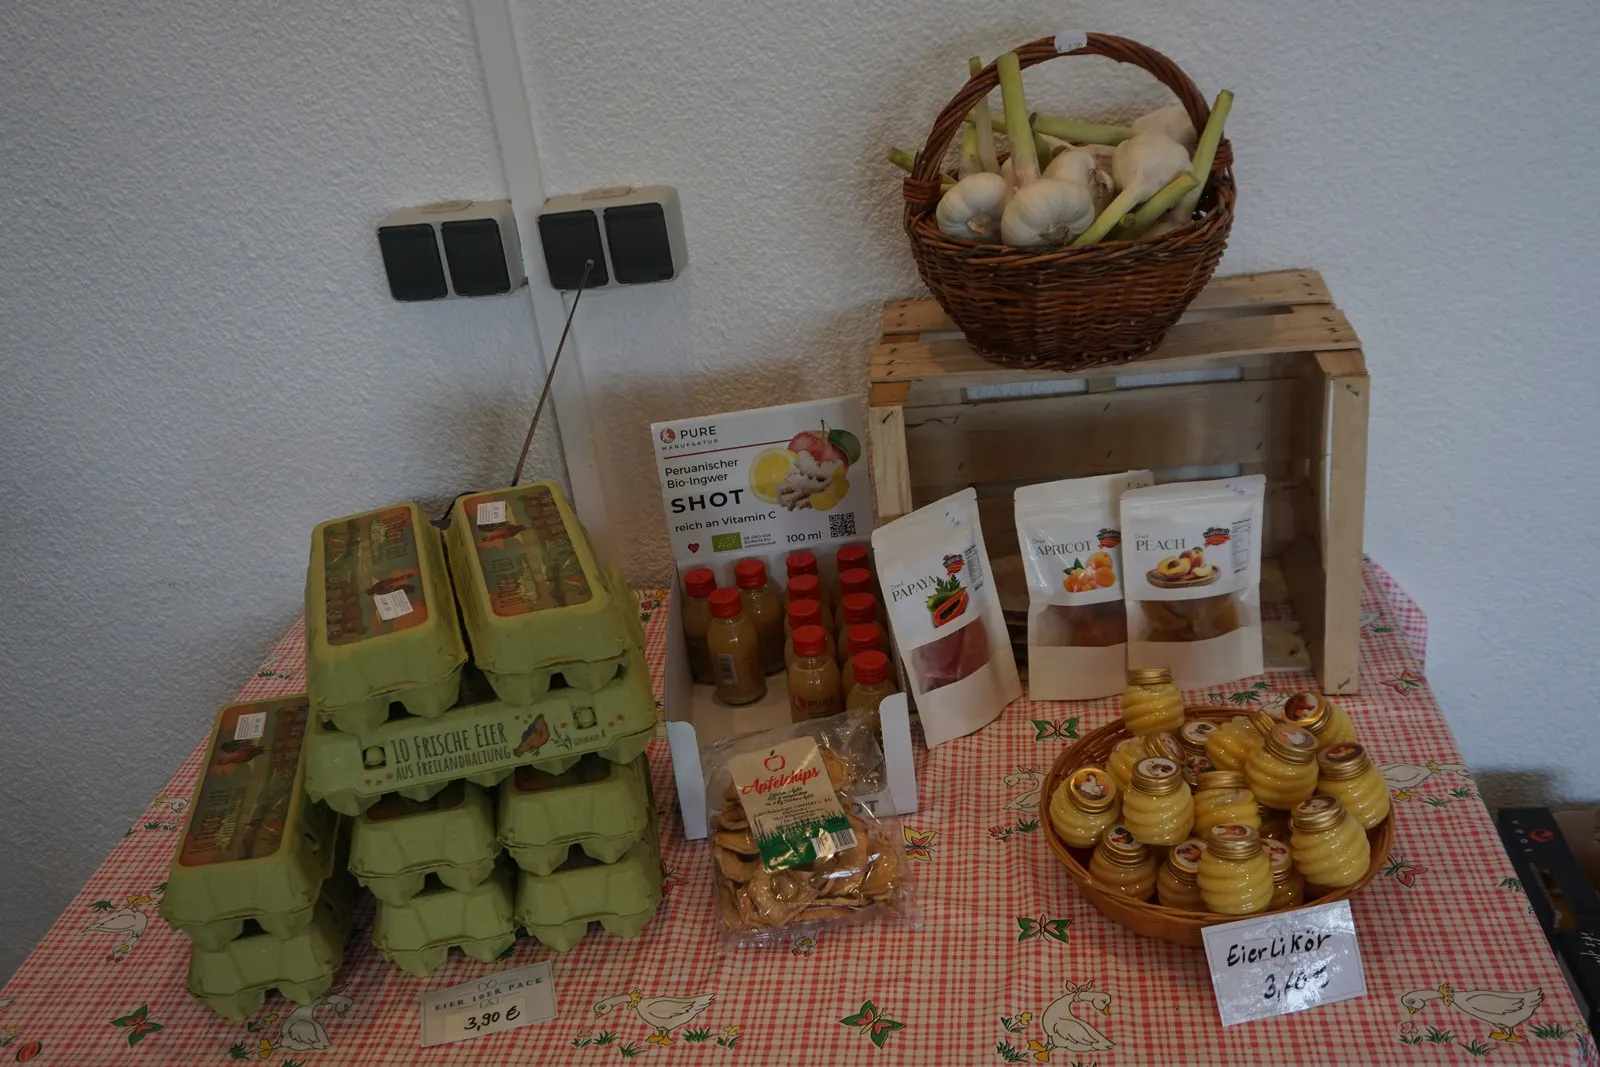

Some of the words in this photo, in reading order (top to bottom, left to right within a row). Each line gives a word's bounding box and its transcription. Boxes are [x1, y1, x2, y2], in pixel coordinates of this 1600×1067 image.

[680, 425, 717, 439] PURE
[661, 439, 719, 451] MANUFAKTUR
[664, 459, 739, 477] Peruanischer
[666, 472, 729, 489] Bio-Ingwer
[670, 489, 744, 514] SHOT
[675, 520, 703, 533] reich
[705, 519, 720, 529] an
[721, 513, 766, 526] Vitamin
[768, 510, 777, 519] C
[786, 533, 806, 543] 100
[807, 530, 822, 541] ml
[1135, 538, 1187, 552] PEACH
[1036, 540, 1092, 557] APRICOT
[891, 575, 937, 602] PAPAYA
[808, 695, 837, 711] PURE
[391, 737, 410, 764] 10
[414, 727, 469, 759] FRISCHE
[475, 721, 508, 748] EIER
[395, 763, 414, 781] AUS
[416, 745, 511, 778] FREILANDHALTUNG
[741, 766, 821, 797] Apfelchips
[434, 999, 465, 1011] EIER
[472, 988, 502, 1002] 10ER
[508, 977, 544, 991] PACK
[464, 1011, 501, 1031] 3,90
[506, 1005, 521, 1021] €
